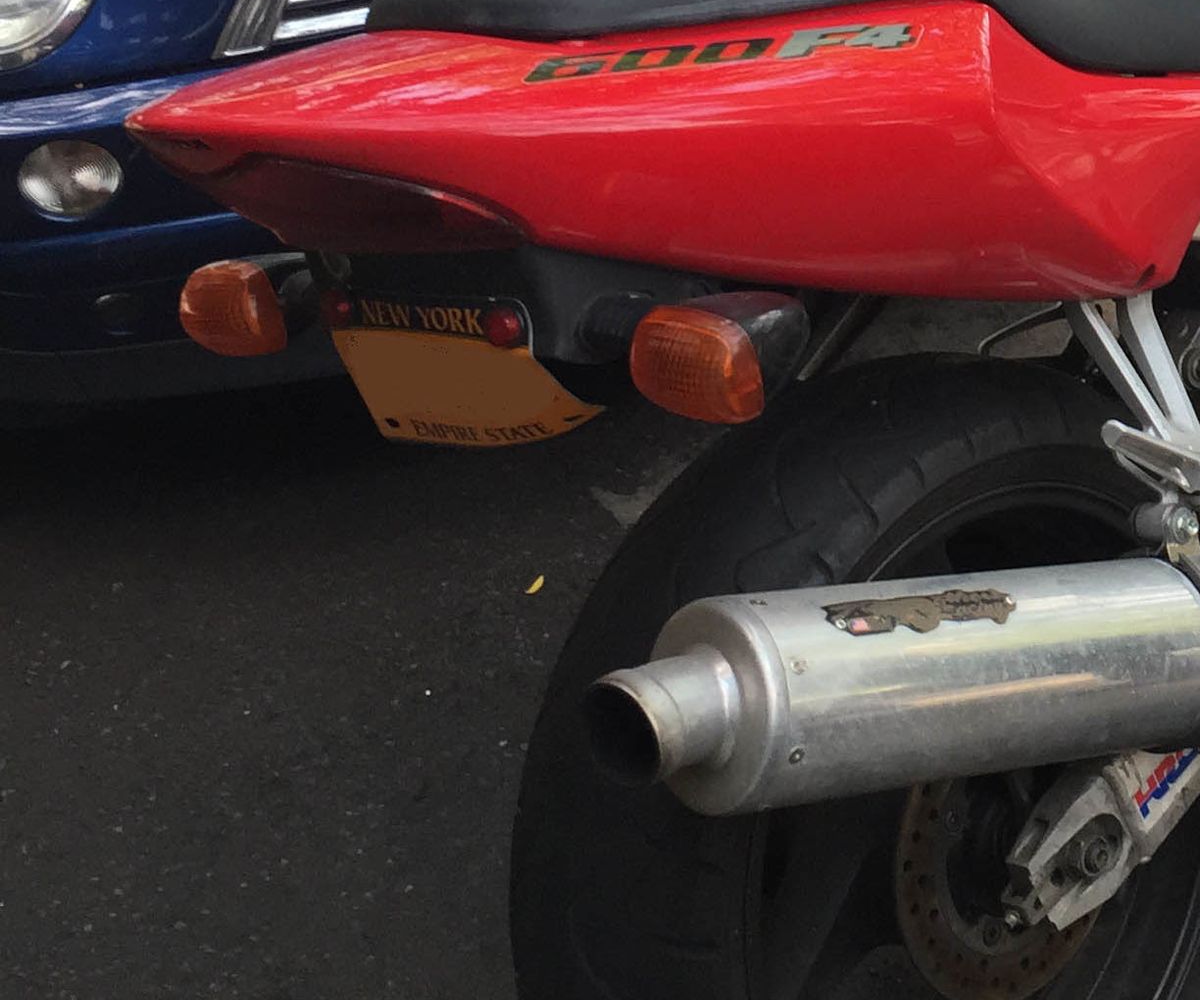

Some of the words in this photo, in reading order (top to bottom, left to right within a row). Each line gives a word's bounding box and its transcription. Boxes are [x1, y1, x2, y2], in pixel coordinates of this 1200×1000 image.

[361, 299, 411, 328] NEW
[415, 305, 484, 335] YORK
[410, 418, 478, 441] EMPIRE
[484, 421, 552, 441] STATE
